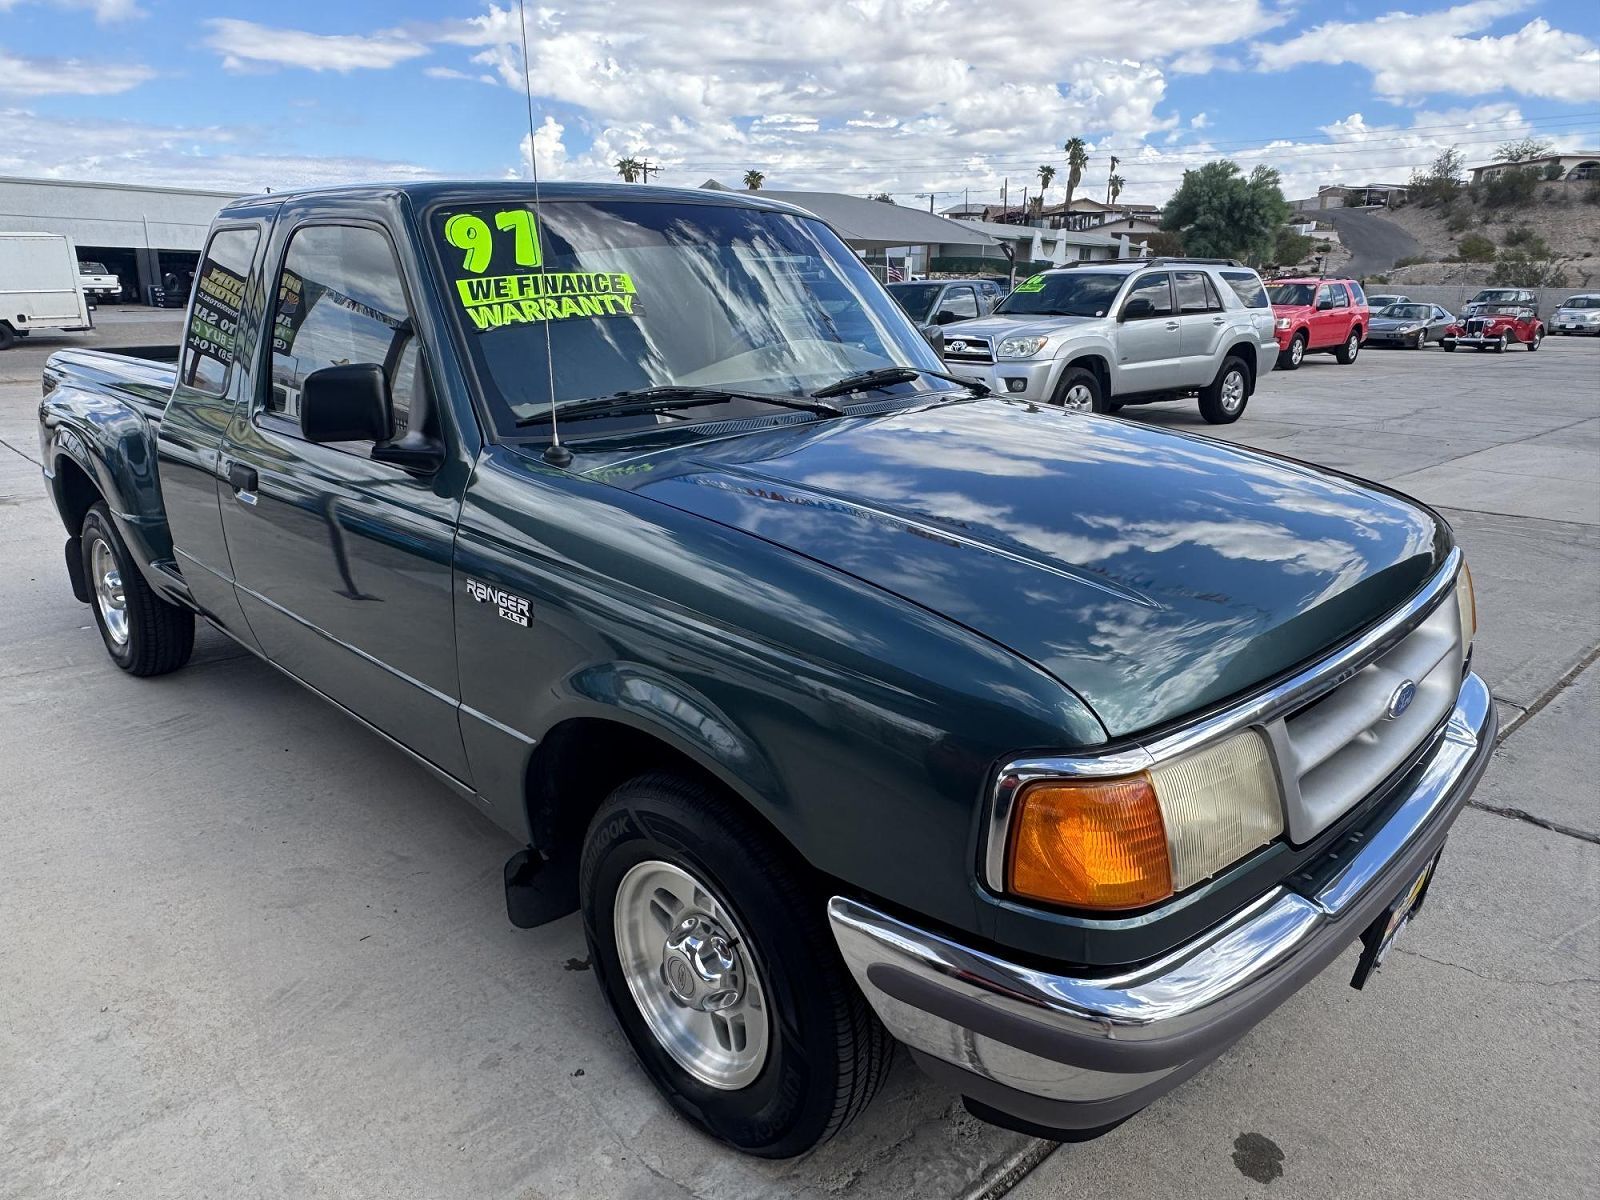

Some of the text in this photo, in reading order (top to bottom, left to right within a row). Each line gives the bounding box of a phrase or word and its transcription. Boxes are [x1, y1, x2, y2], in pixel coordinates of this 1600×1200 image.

[445, 210, 541, 273] 97
[467, 273, 625, 301] WE FINANCE
[466, 295, 634, 330] WARRANTY
[466, 578, 530, 616] RANGER
[500, 608, 527, 625] XLT
